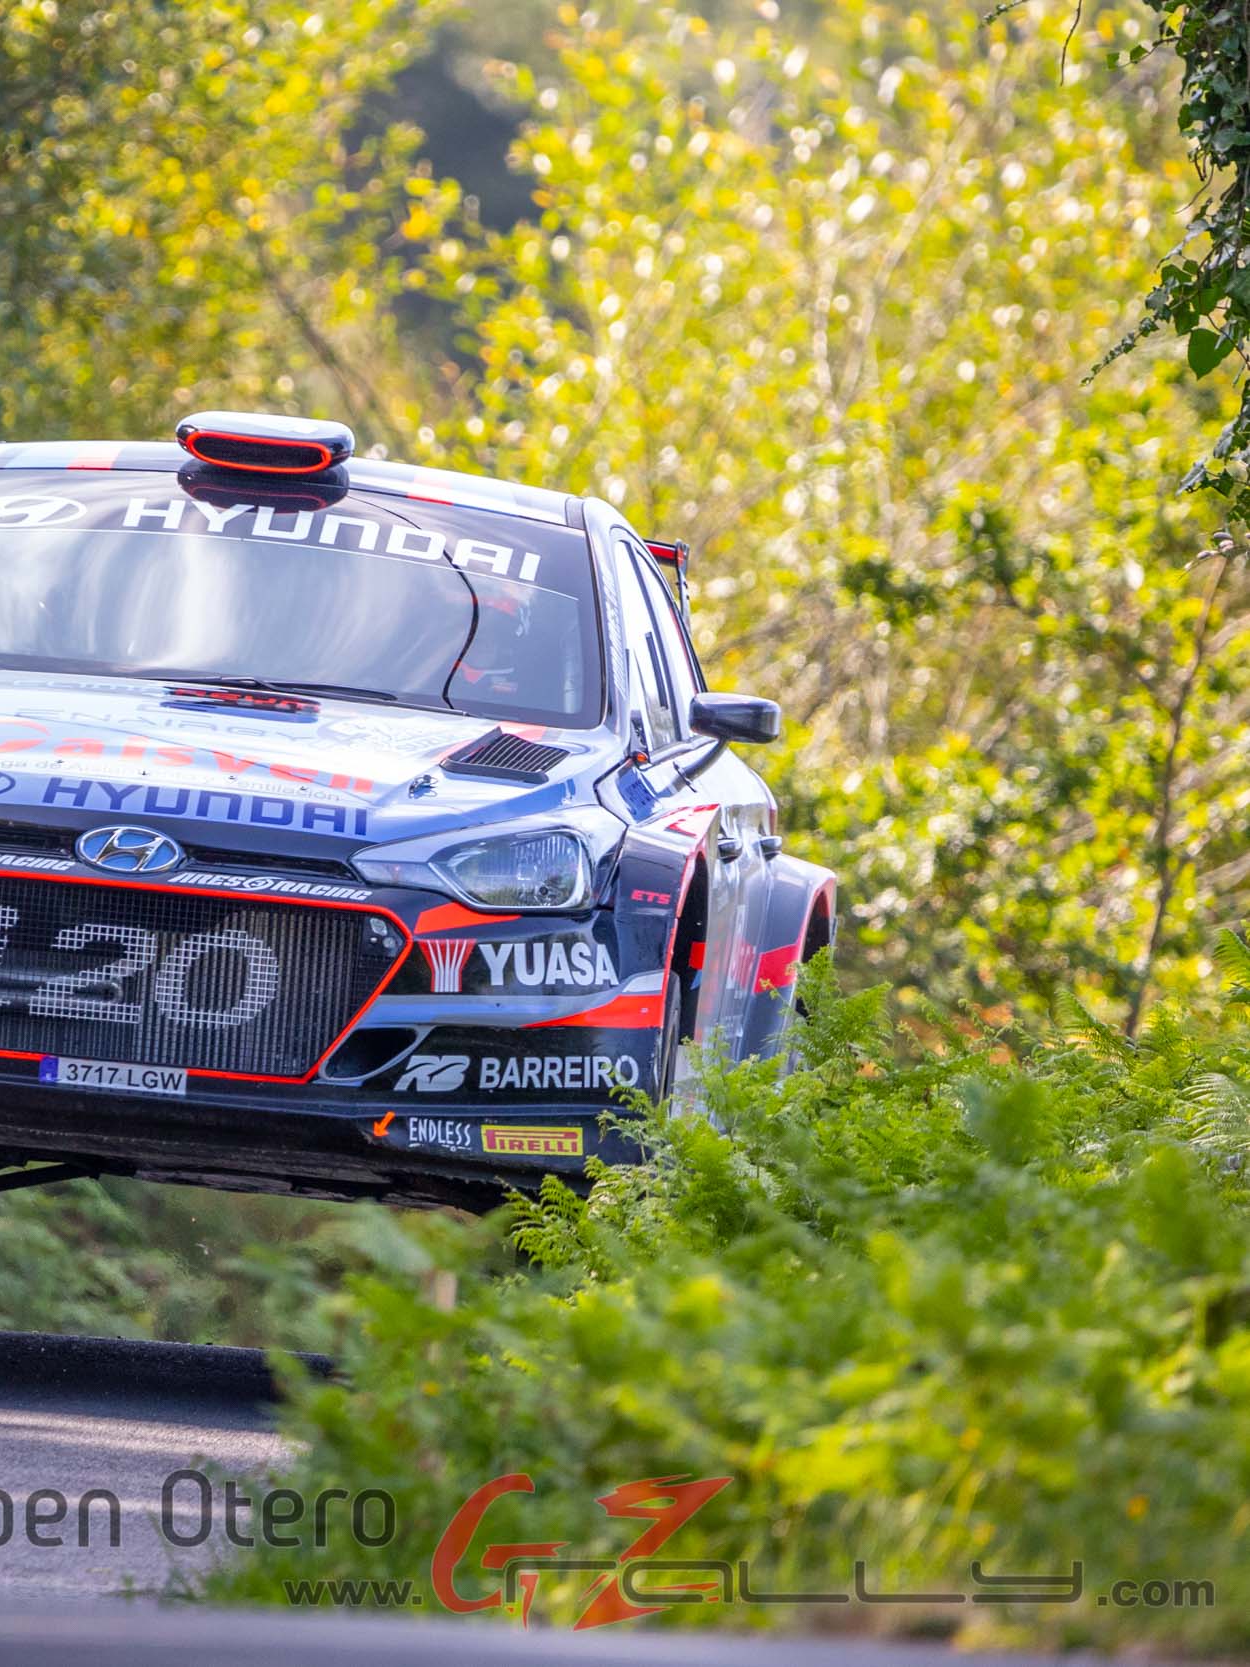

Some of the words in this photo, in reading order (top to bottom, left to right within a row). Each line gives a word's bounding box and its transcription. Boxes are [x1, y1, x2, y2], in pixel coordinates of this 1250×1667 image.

[123, 497, 542, 582] HYUNDAI
[42, 777, 367, 836] HYUNDAI
[631, 889, 671, 904] ETS
[478, 942, 619, 985] YUASA
[66, 1063, 119, 1084] 3717
[127, 1068, 183, 1090] LGW
[478, 1054, 639, 1090] BARREIRO
[408, 1117, 471, 1149] ENDLESS
[484, 1129, 578, 1153] PIRELLI
